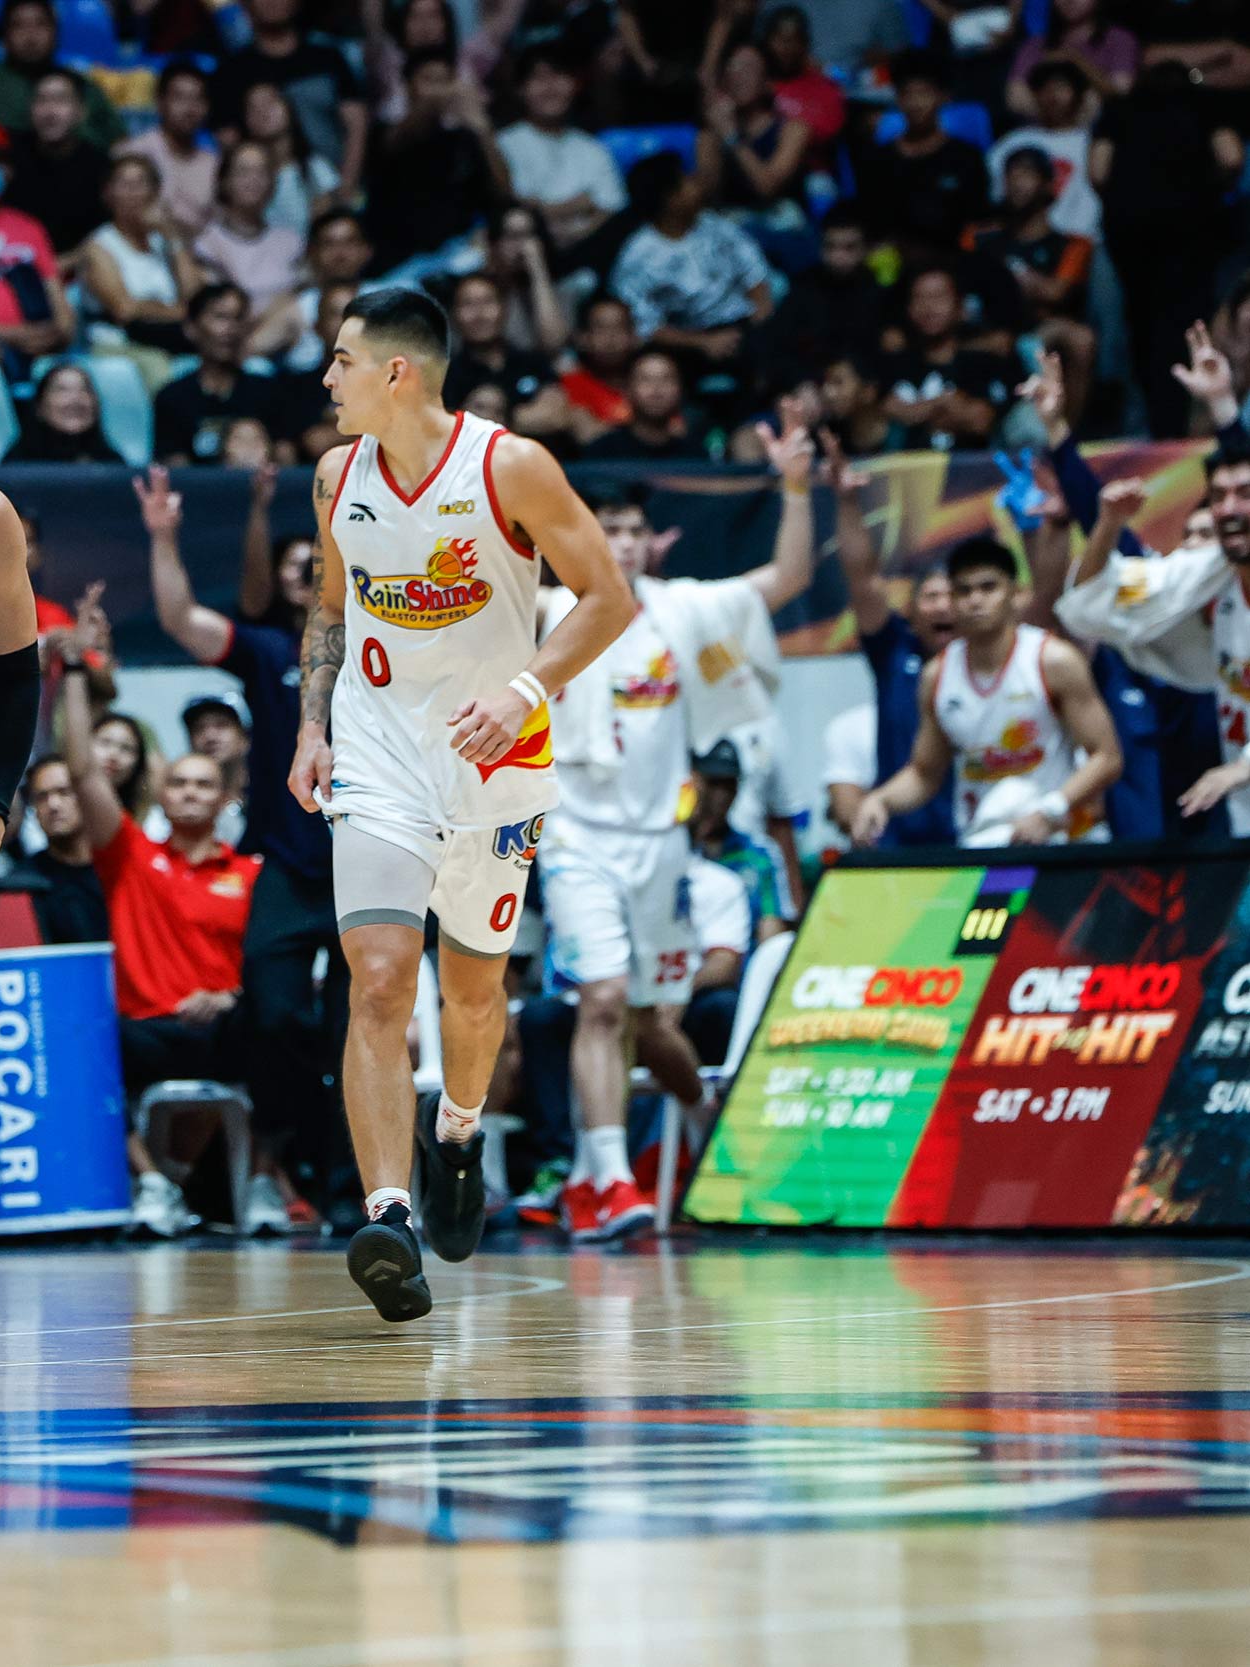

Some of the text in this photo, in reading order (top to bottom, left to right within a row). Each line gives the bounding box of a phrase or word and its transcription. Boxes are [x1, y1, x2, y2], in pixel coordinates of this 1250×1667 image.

[351, 566, 407, 610] Rain
[405, 580, 488, 613] Shine
[361, 637, 392, 688] 0
[489, 892, 517, 933] 0
[969, 1014, 1071, 1066] HIT
[1075, 1009, 1178, 1065] HIT
[973, 1086, 1112, 1123] SAT 3 PM
